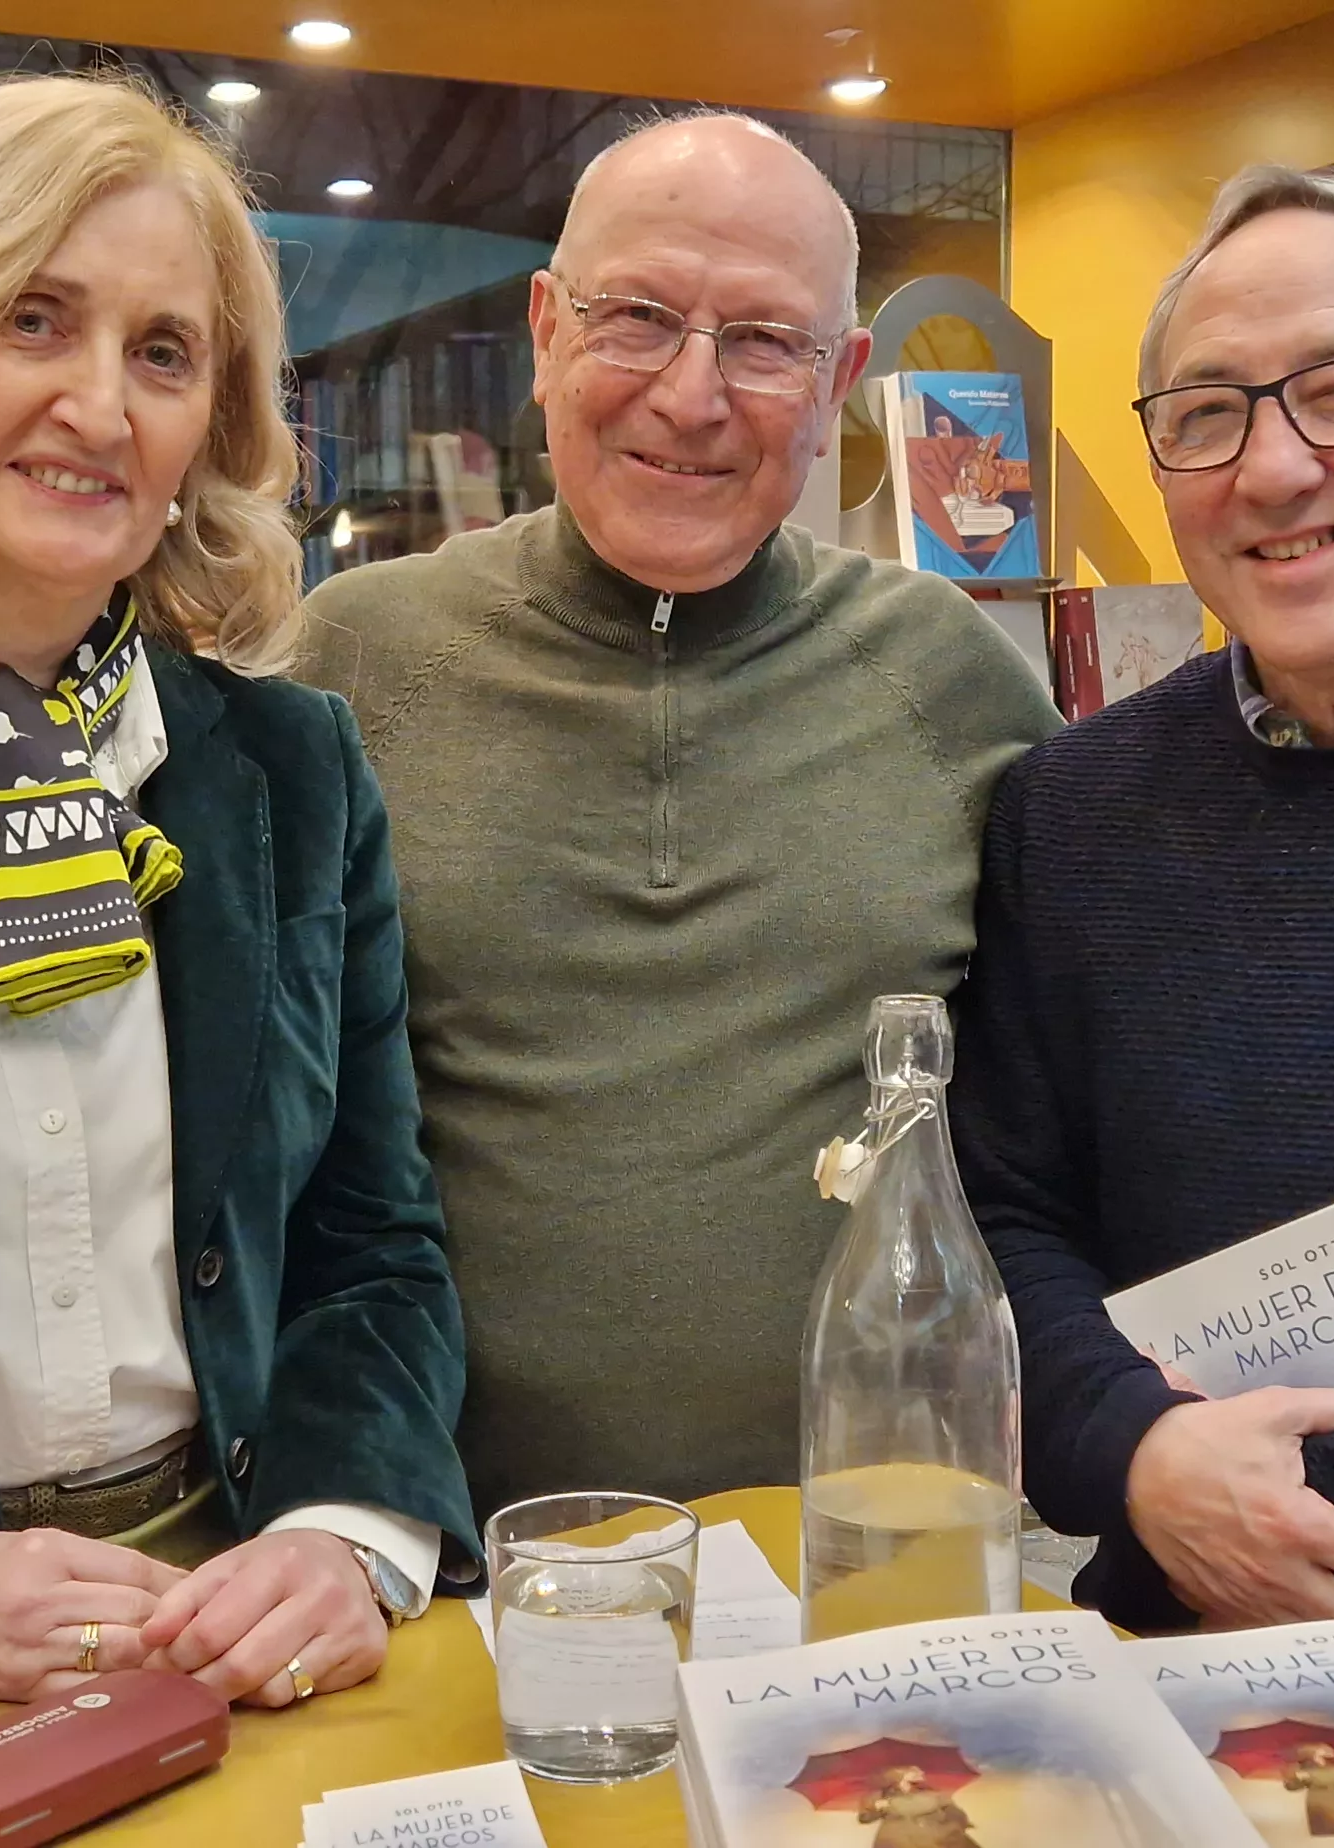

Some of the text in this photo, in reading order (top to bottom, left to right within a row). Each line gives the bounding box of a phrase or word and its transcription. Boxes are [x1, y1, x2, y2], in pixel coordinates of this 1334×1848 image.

[1258, 1258, 1298, 1281] SOL
[1149, 1333, 1196, 1365] LA
[1200, 1283, 1318, 1349] MUJER
[920, 1626, 1070, 1648] SOL OTTO
[725, 1641, 1085, 1706] LA MUJER DE
[853, 1662, 1097, 1709] MARCOS
[353, 1804, 515, 1844] LA MUJER DE
[394, 1799, 464, 1818] SOL OTTO
